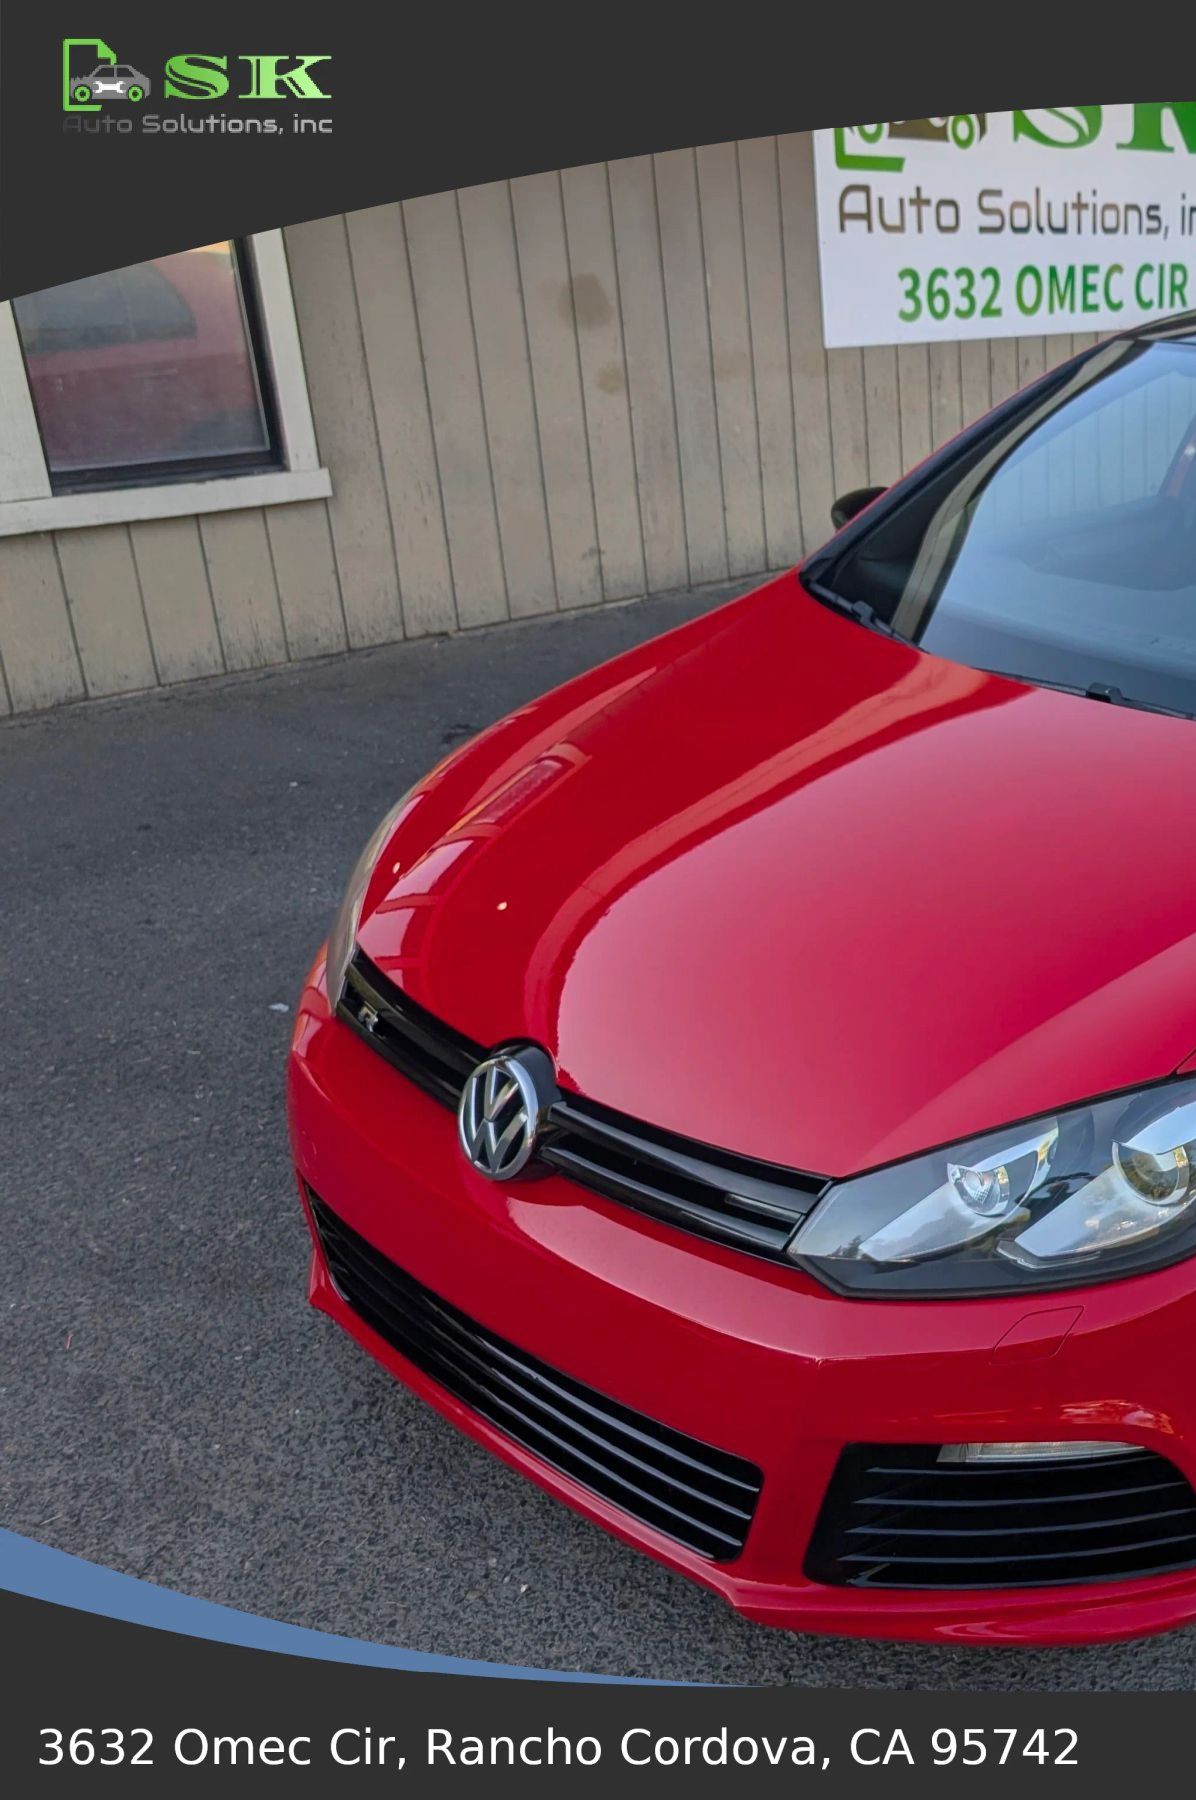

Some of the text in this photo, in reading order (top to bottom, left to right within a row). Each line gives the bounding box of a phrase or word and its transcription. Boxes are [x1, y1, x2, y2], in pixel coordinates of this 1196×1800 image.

[839, 185, 960, 234] Auto
[977, 187, 1170, 240] Solutions,
[898, 263, 1189, 322] 3632 OMEC CIR
